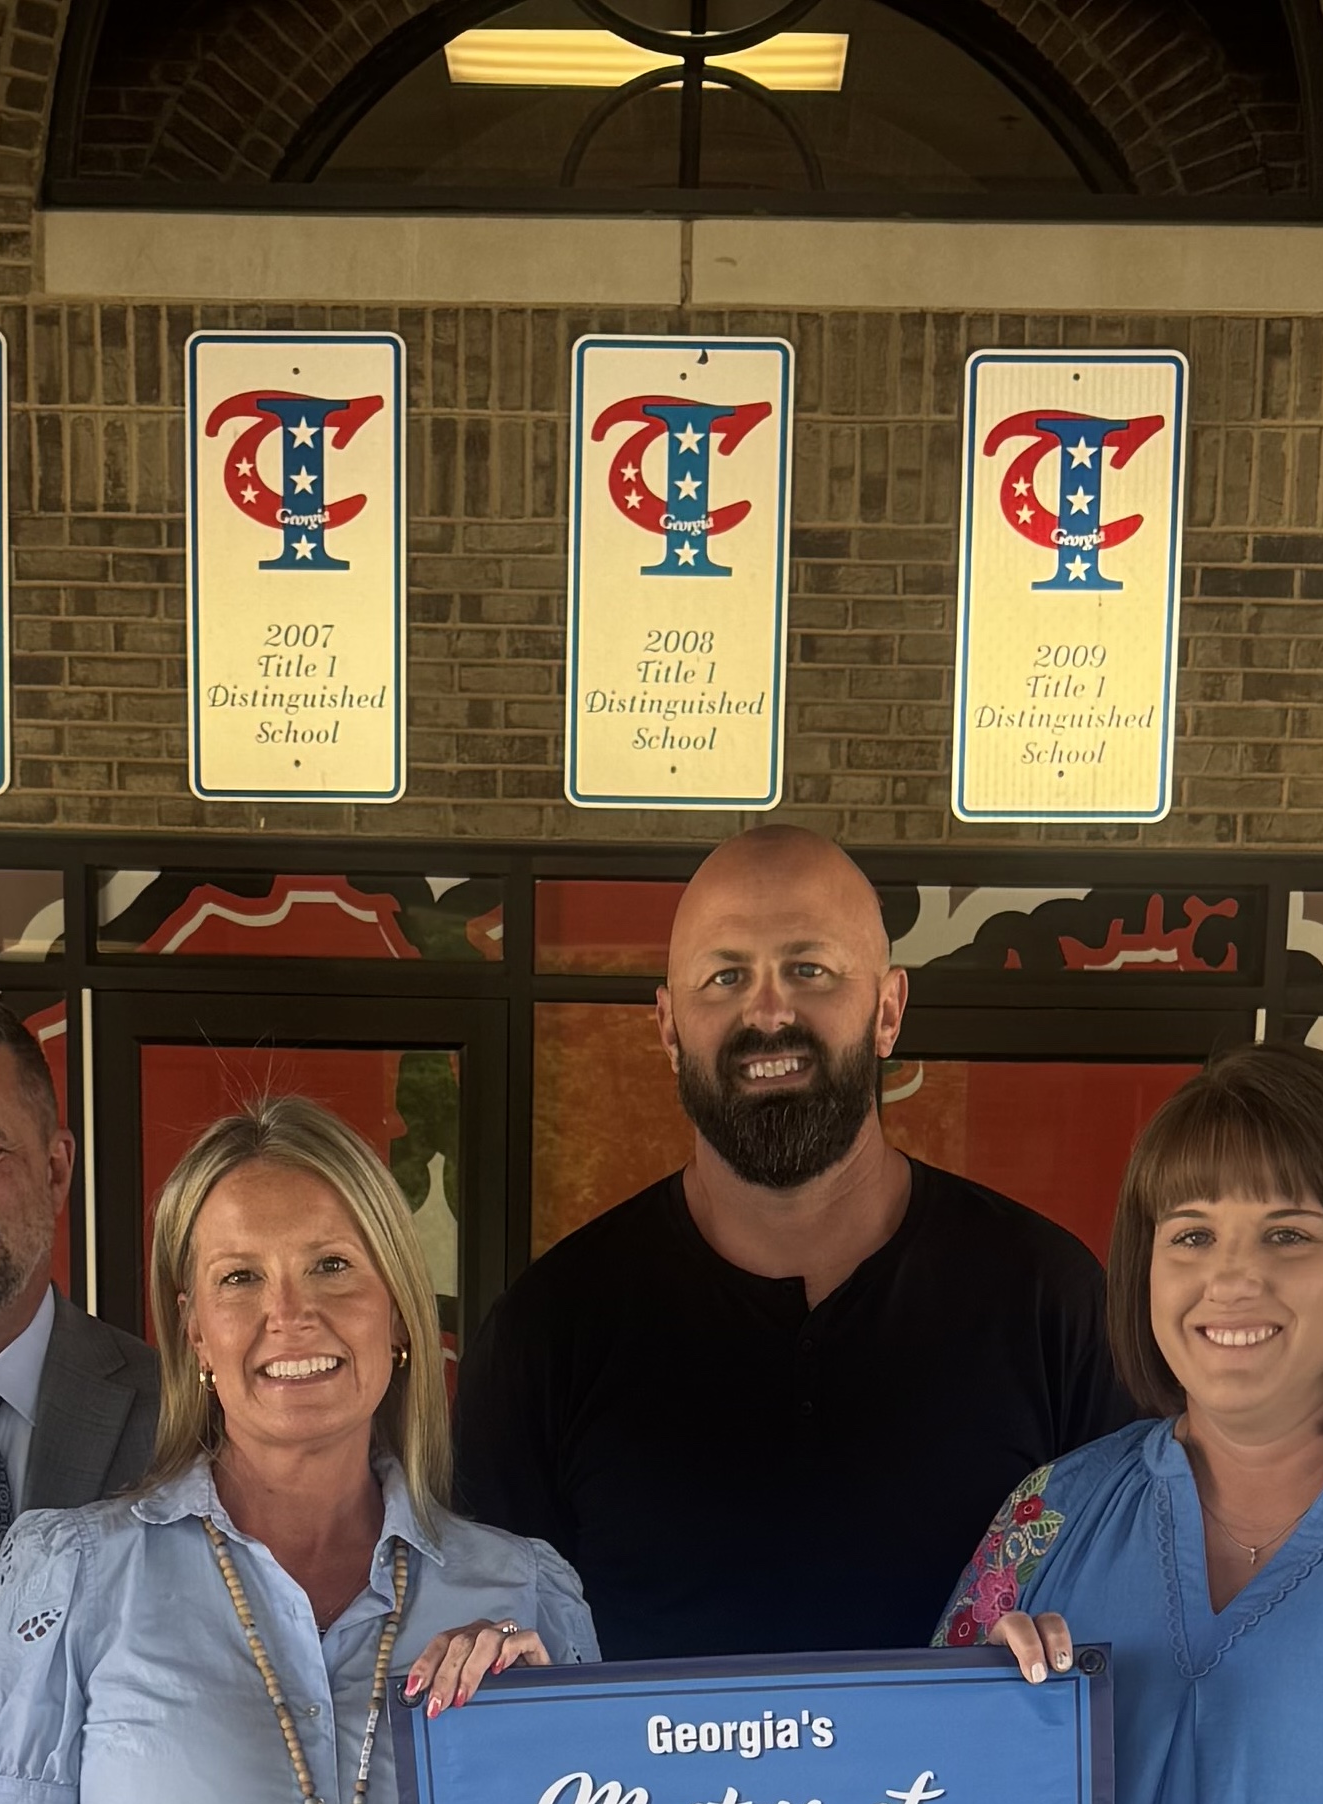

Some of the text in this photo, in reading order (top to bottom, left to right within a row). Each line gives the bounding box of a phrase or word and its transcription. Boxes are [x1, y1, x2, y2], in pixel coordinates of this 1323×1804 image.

[276, 507, 330, 530] Georgia
[659, 513, 713, 535] Georgia
[1050, 527, 1106, 550] Georgia
[265, 625, 334, 648] 2007
[645, 630, 714, 653] 2008
[258, 654, 316, 677] Title
[1034, 645, 1106, 667] 2009
[637, 660, 695, 683] Title
[1027, 675, 1085, 697] Title
[208, 684, 386, 715] Distinguished
[586, 690, 765, 720] Distinguished
[976, 705, 1154, 733] Distinguished
[256, 721, 339, 743] School
[633, 726, 716, 750] School
[1022, 741, 1105, 763] School
[648, 1710, 833, 1758] Georgia's
